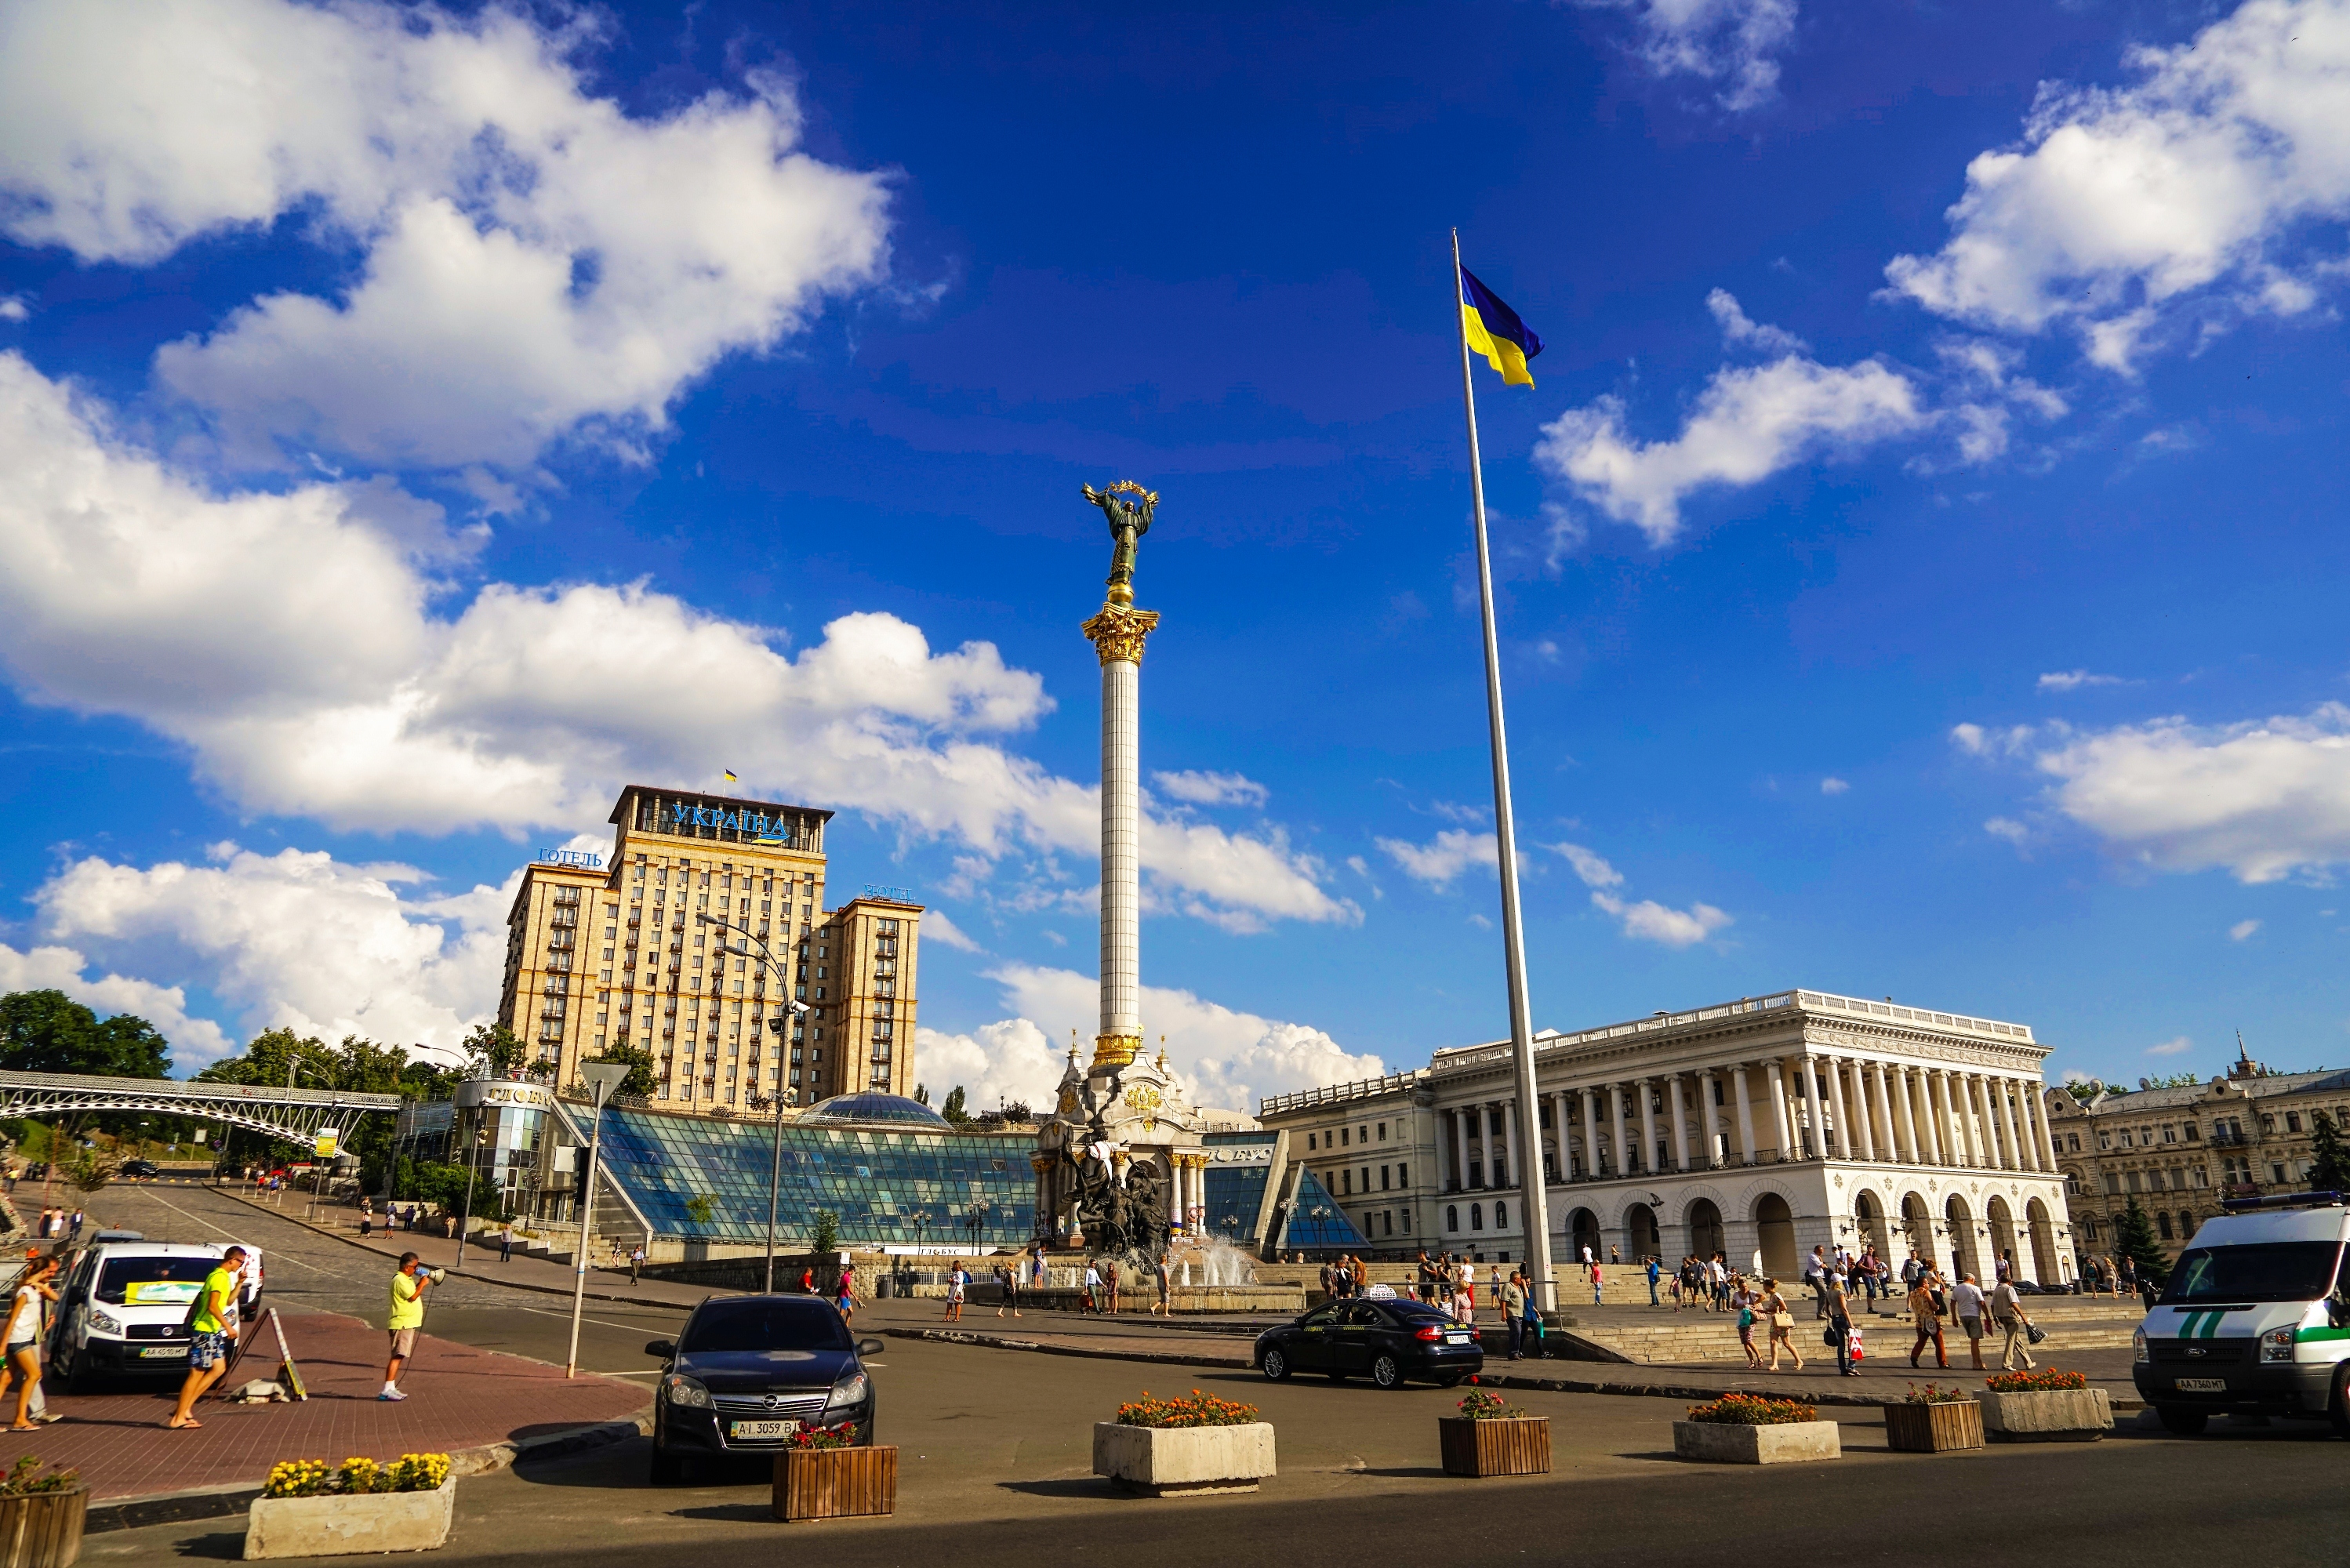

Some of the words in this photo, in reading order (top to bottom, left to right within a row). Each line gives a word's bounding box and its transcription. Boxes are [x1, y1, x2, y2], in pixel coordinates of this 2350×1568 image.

[672, 804, 787, 836] УКРАЇНА
[537, 848, 602, 866] ГОТЕЛЬ
[863, 884, 915, 901] HOTEL
[739, 1423, 751, 1434] AI
[757, 1423, 780, 1434] 3059
